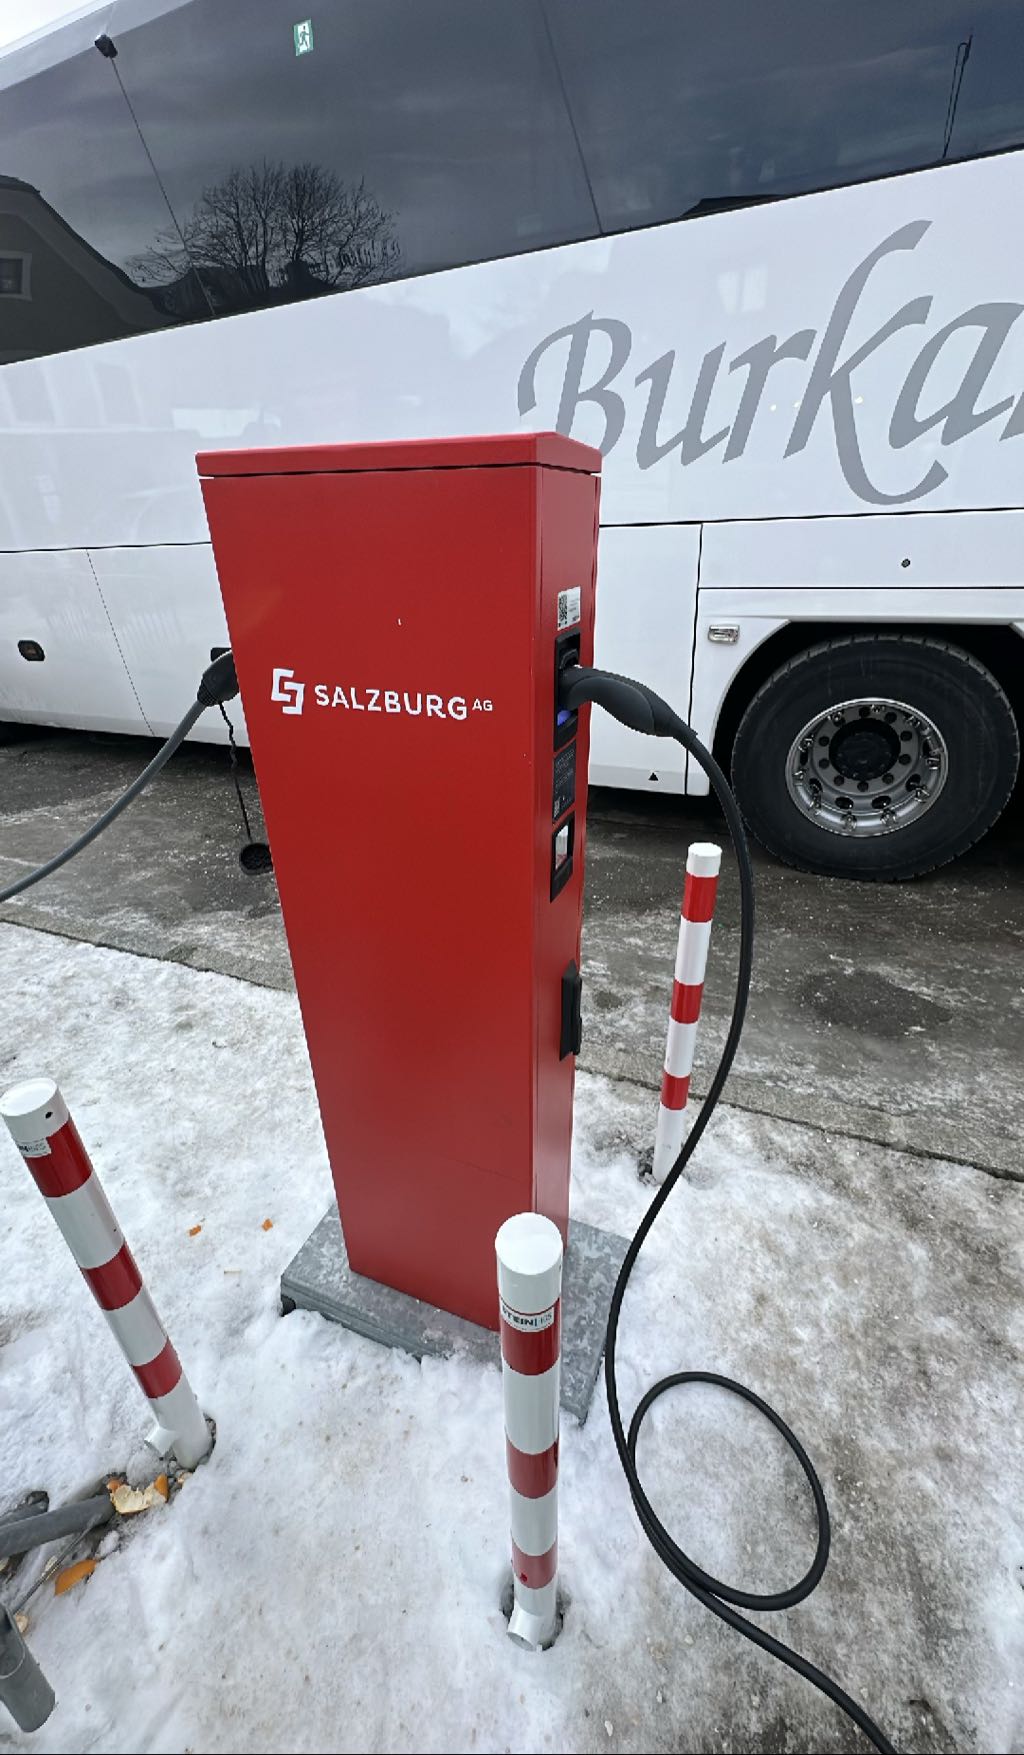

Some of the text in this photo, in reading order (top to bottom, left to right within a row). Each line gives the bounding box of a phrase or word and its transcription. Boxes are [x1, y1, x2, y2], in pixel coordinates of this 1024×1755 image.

[517, 219, 1024, 505] Burka
[314, 684, 494, 720] SALZBURG AG
